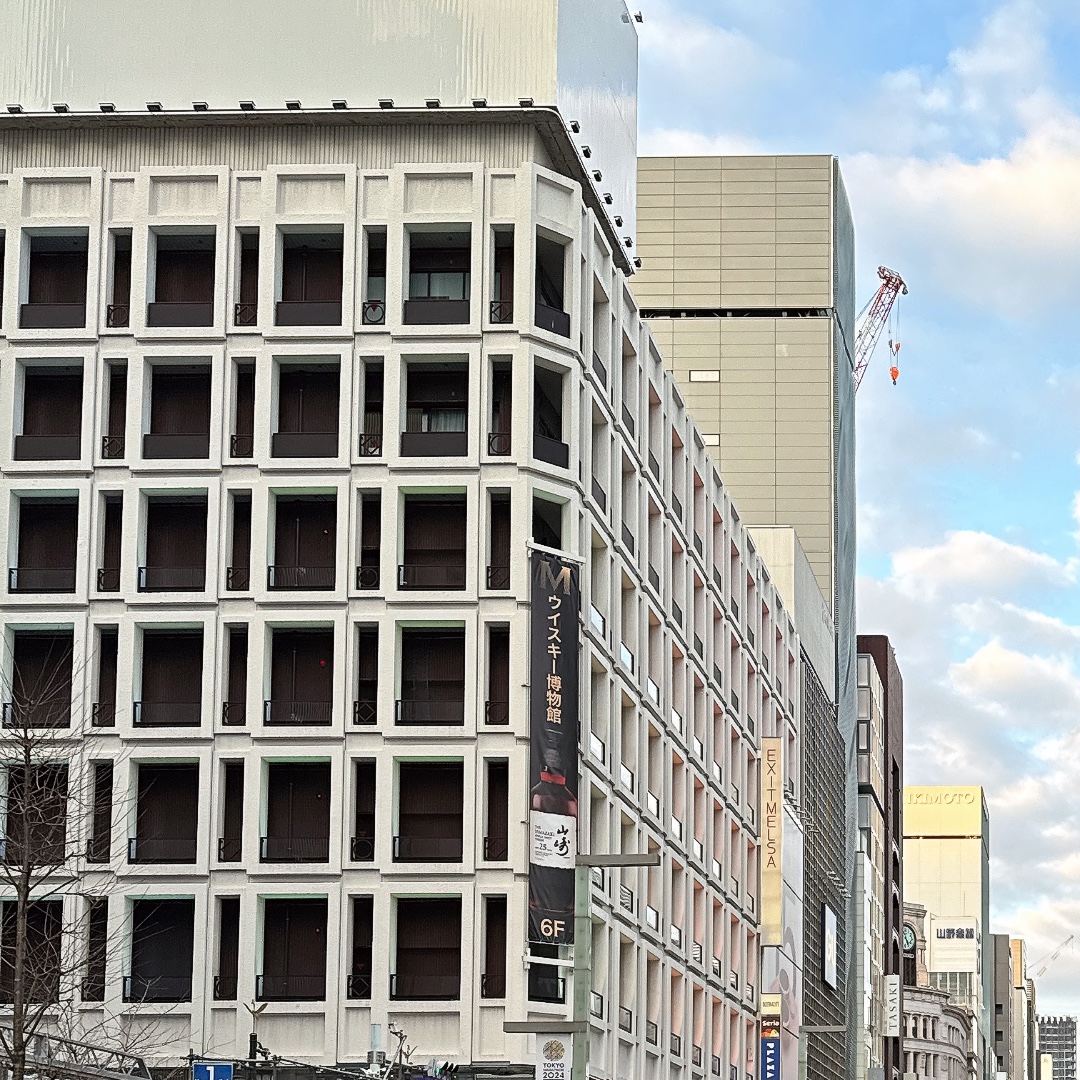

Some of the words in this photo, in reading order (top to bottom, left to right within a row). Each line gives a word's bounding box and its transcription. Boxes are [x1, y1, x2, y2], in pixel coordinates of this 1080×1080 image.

[546, 594, 562, 725] ウイスキー博物館
[540, 918, 566, 938] 6F
[888, 982, 898, 1030] TASAKI
[542, 1071, 565, 1079] 2024
[766, 1042, 775, 1079] PLAZA
